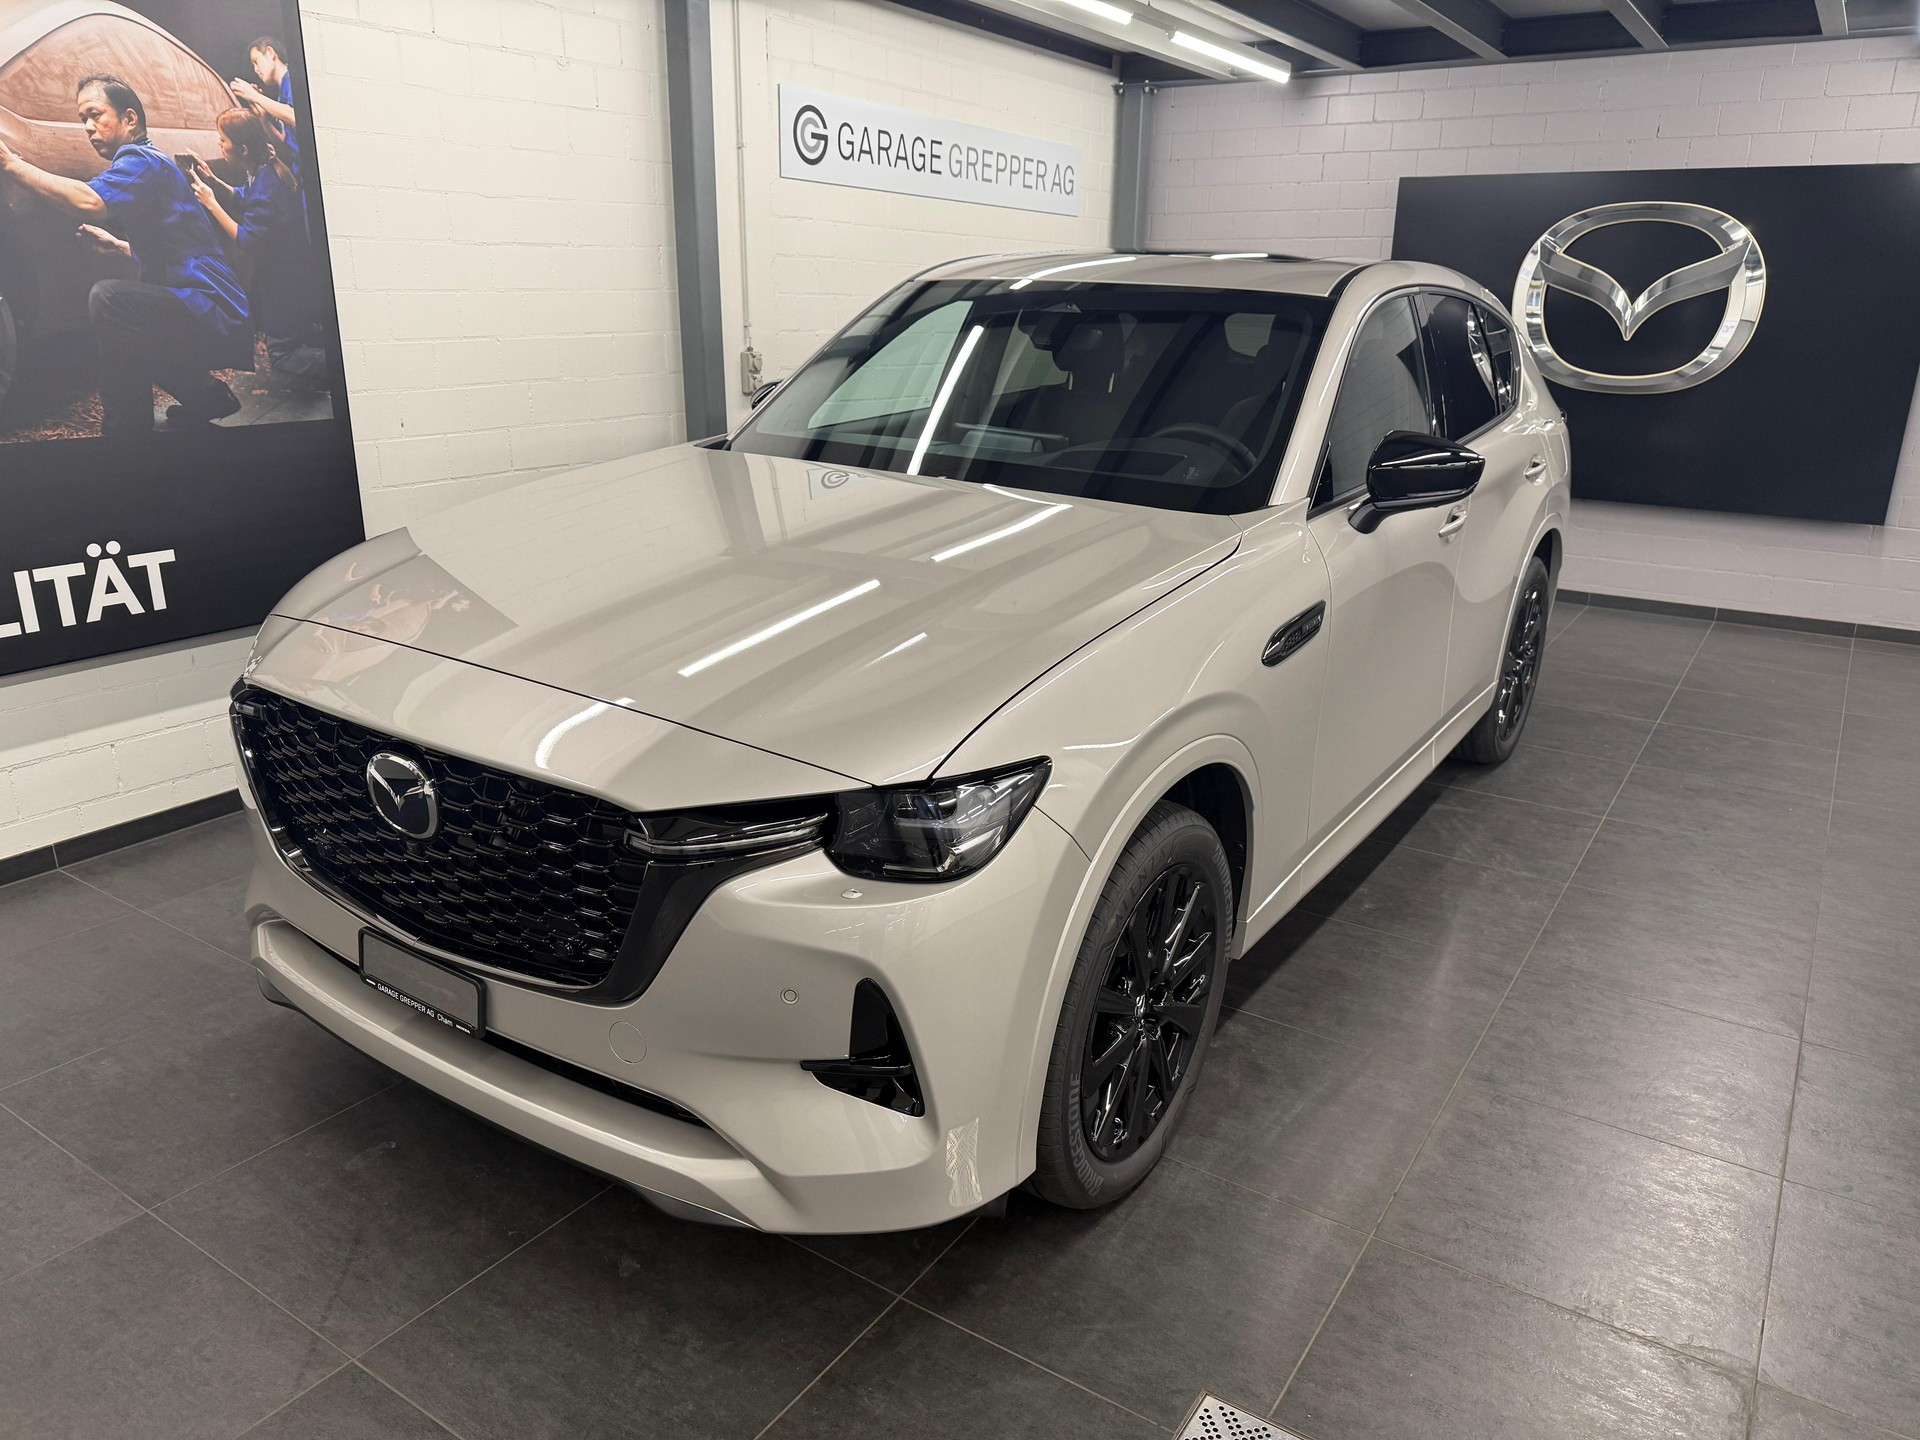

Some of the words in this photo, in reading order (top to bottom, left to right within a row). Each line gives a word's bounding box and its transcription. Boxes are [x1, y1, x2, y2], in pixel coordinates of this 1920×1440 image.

[837, 122, 943, 175] GARAGE
[949, 143, 1047, 192] GREPPER
[1050, 163, 1075, 196] AG
[377, 983, 399, 1000] GARAGE
[400, 994, 426, 1014] GREPPER
[426, 1007, 435, 1018] AG
[437, 1013, 454, 1027] Cham
[1068, 1072, 1105, 1197] BRIDGESTONE
